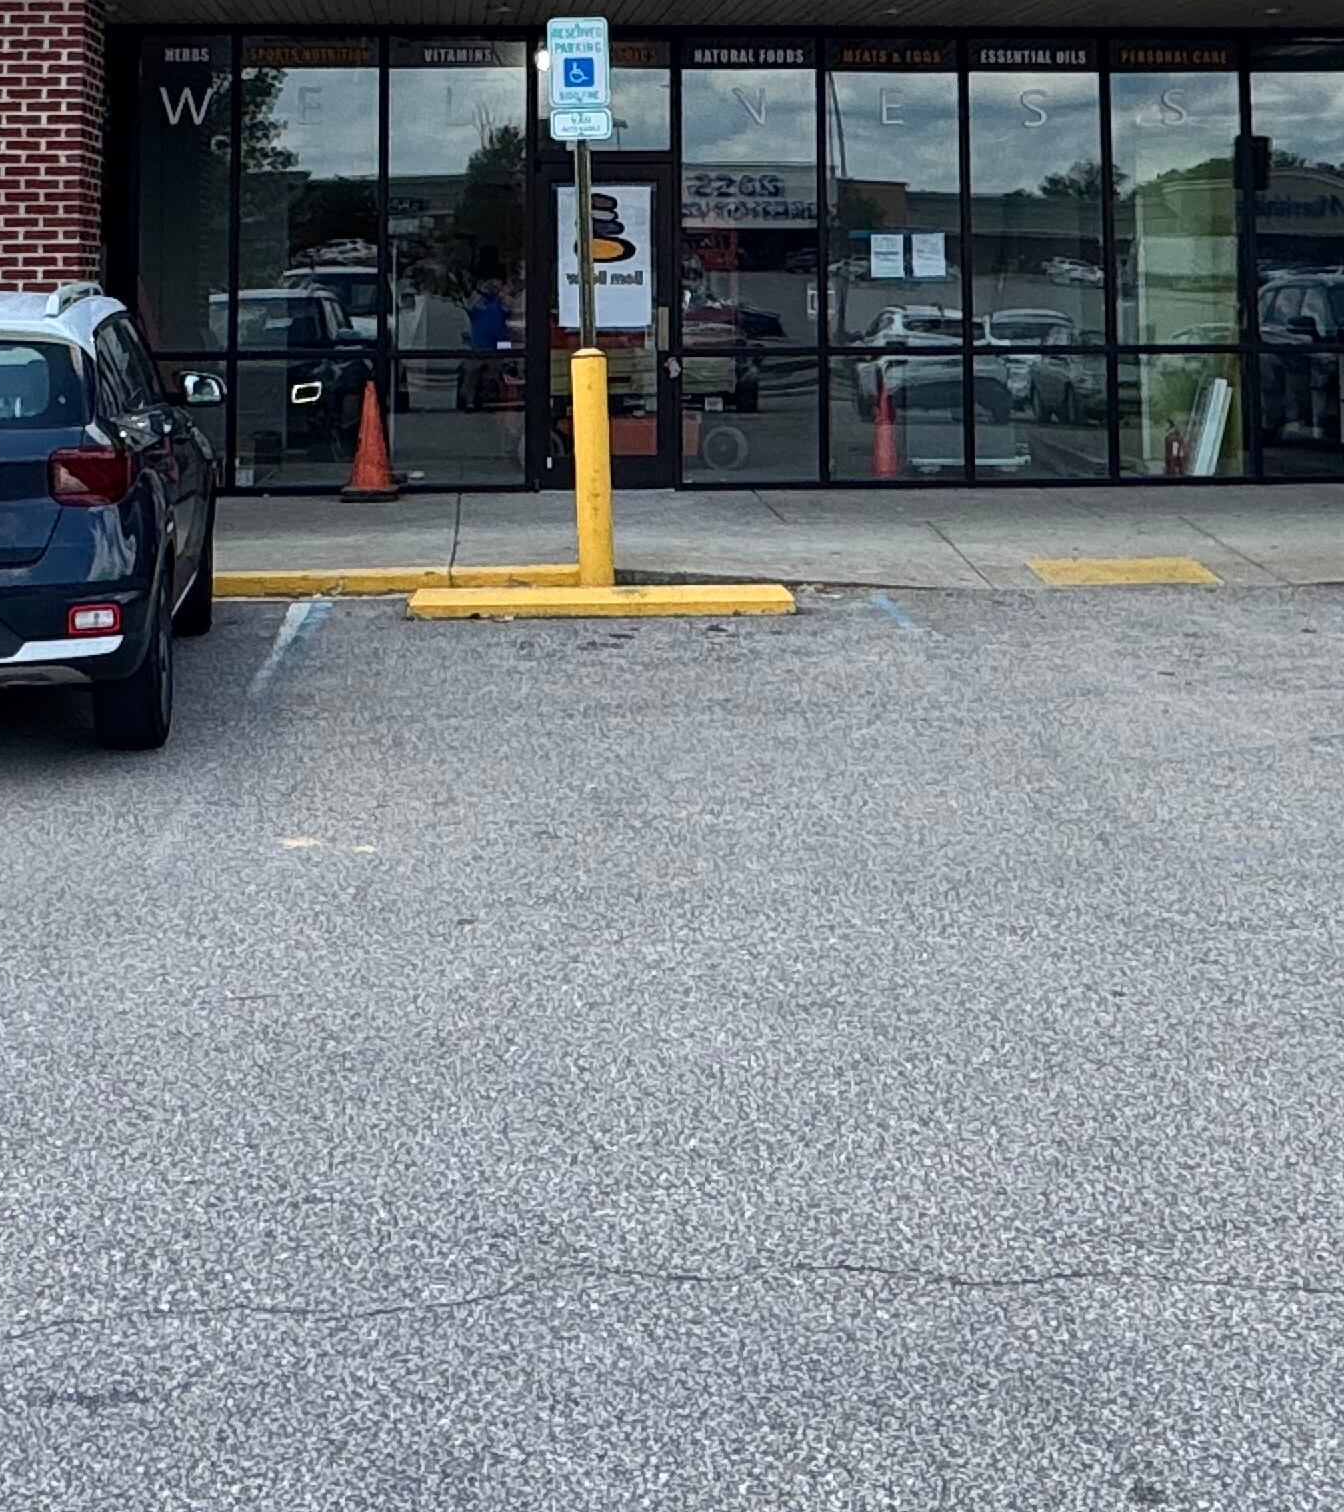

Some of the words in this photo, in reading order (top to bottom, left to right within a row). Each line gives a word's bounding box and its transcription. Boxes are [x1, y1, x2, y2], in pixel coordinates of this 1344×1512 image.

[249, 47, 297, 64] SPORTS
[300, 46, 371, 64] NUTRITION
[423, 48, 493, 63] VITAMINS
[554, 42, 603, 54] PARKING
[693, 48, 756, 64] NATURAL
[759, 48, 805, 64] FOODS
[842, 49, 888, 64] MEATS
[980, 48, 1052, 65] ESSENTIAL
[1055, 49, 1087, 65] OILS
[1120, 48, 1188, 65] PERSONAL
[1192, 49, 1228, 65] CARE
